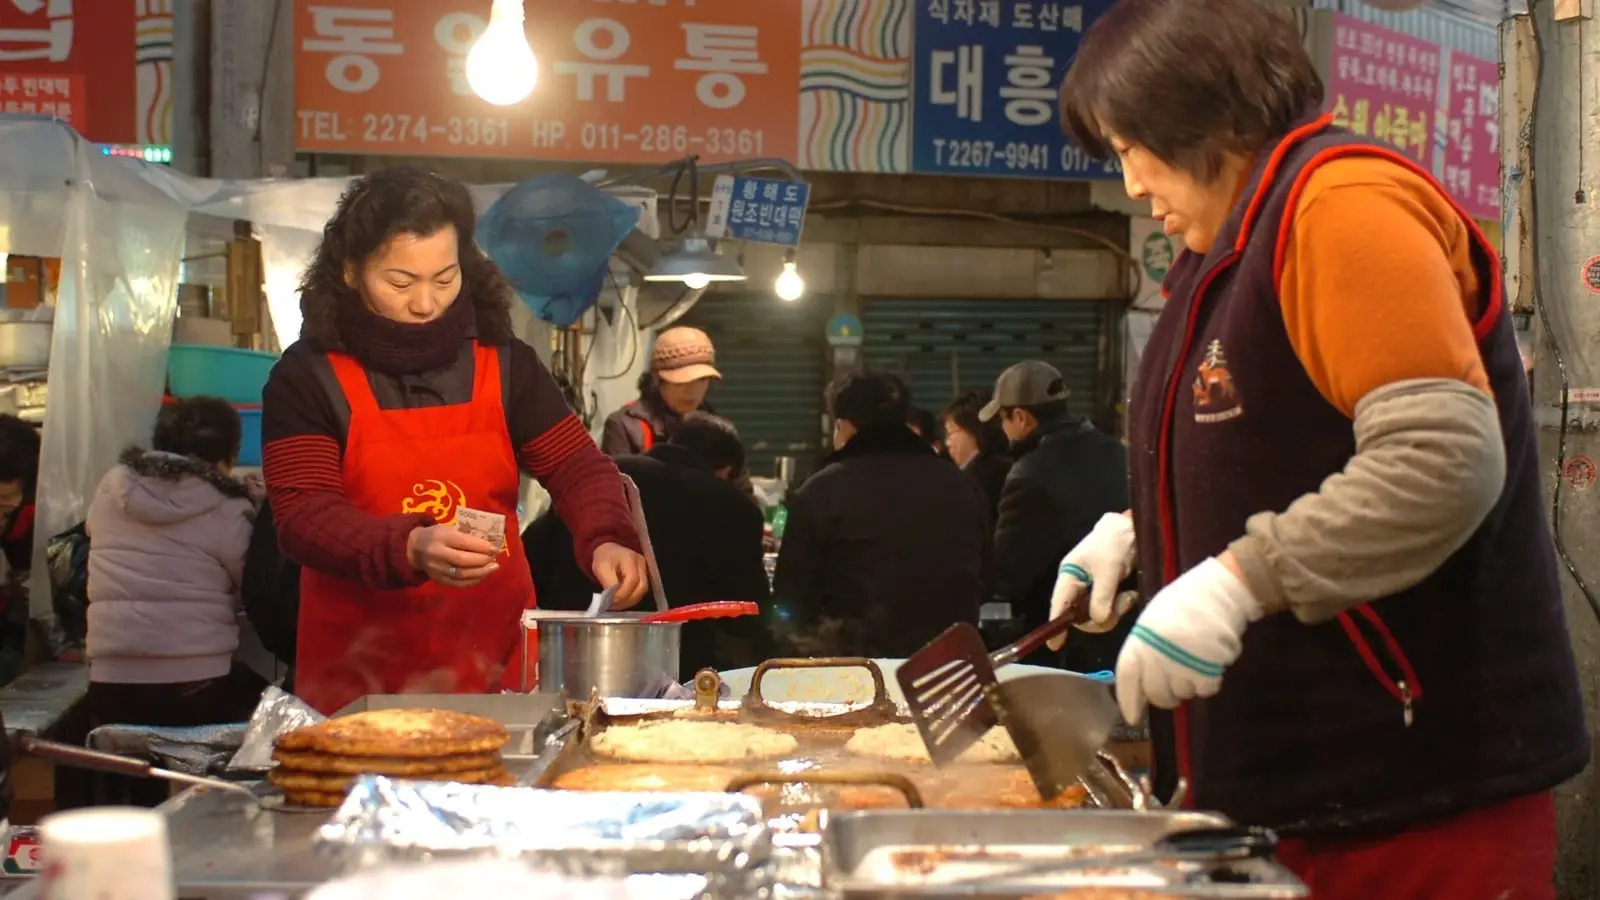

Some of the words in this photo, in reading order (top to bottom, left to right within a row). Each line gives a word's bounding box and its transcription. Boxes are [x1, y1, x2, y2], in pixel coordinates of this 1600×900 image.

[928, 0, 1000, 28] 식자재
[1012, 4, 1083, 33] 도산매
[929, 45, 1058, 126] 대흥
[297, 110, 354, 143] TEL:
[363, 113, 510, 147] 2274-3361
[581, 122, 764, 155] 011-286-3361
